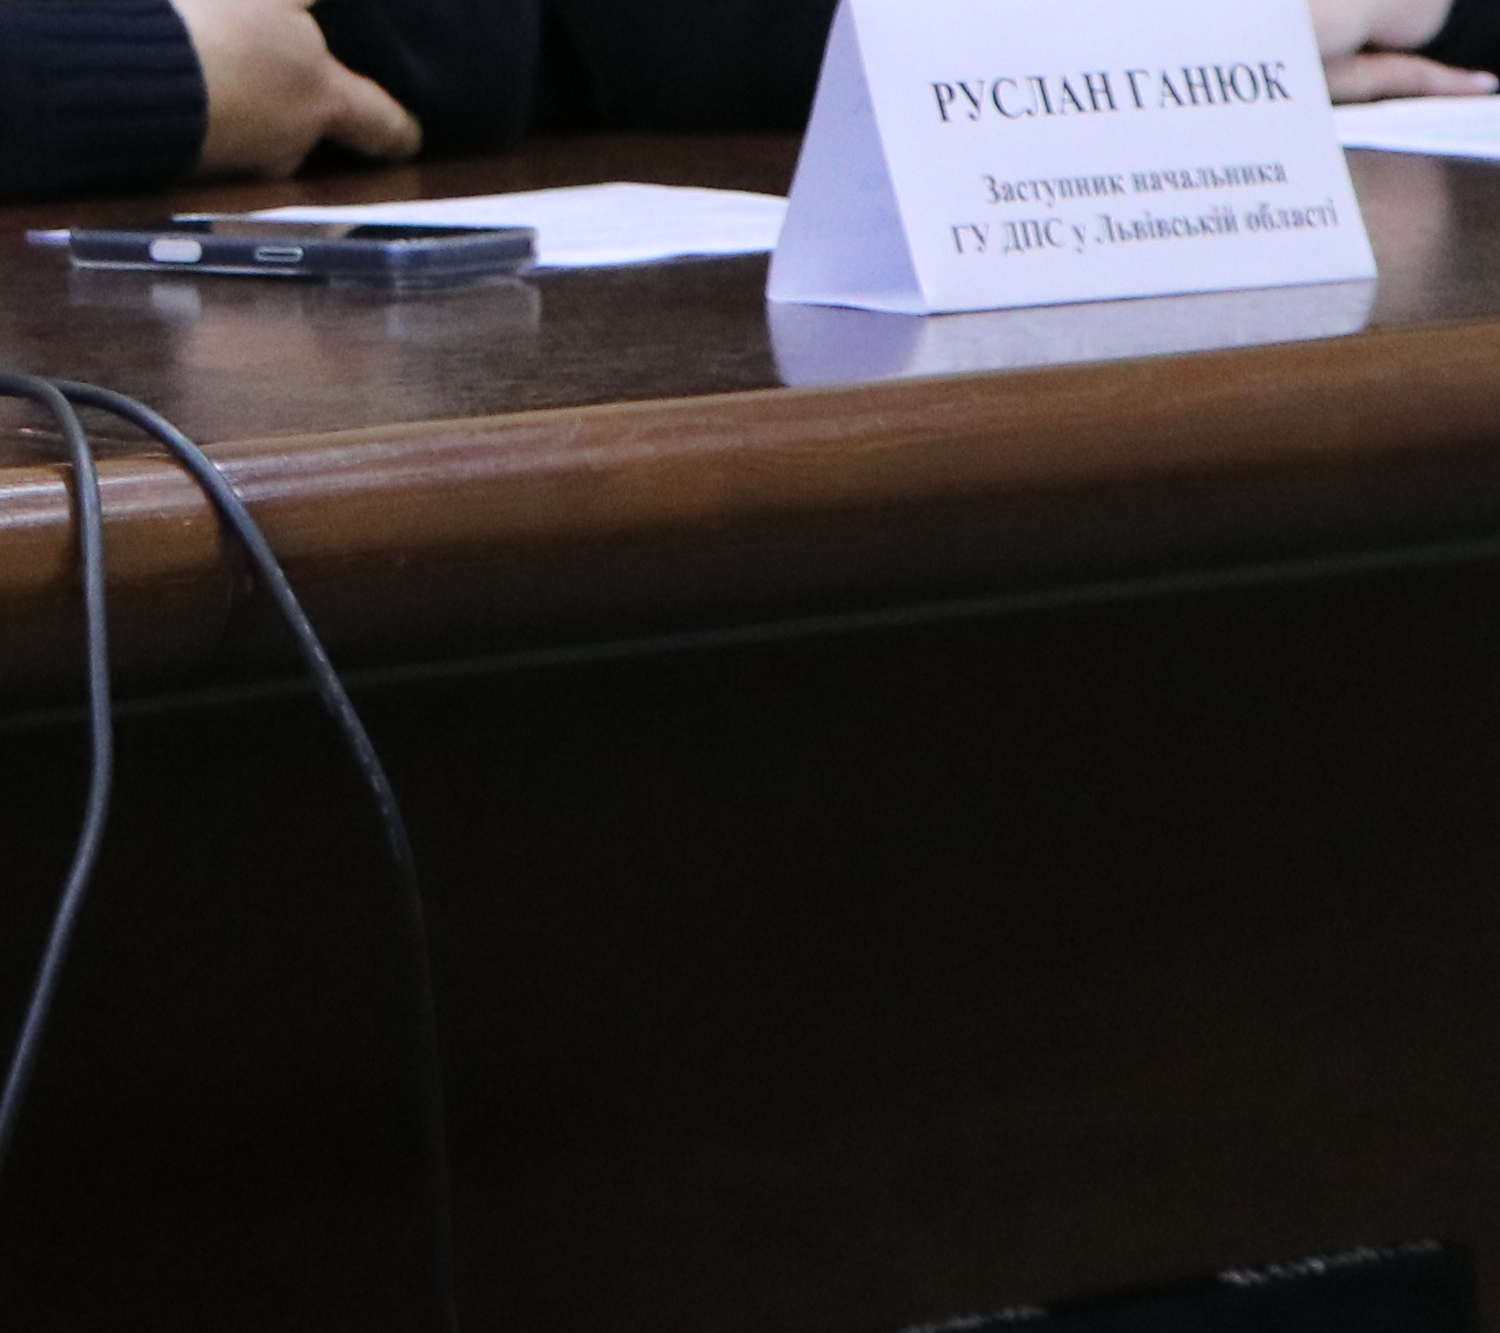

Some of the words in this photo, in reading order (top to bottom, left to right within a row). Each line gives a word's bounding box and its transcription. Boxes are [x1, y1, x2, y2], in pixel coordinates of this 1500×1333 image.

[932, 71, 1118, 123] РУСЛАН
[1126, 62, 1291, 109] ГАНЮК
[984, 173, 1126, 208] Заступник
[1131, 162, 1288, 195] начальника
[950, 223, 989, 255] ГУ
[1002, 219, 1063, 256] ДПС
[1071, 223, 1087, 251] у
[1094, 203, 1240, 244] Львівській
[1245, 199, 1340, 232] області
